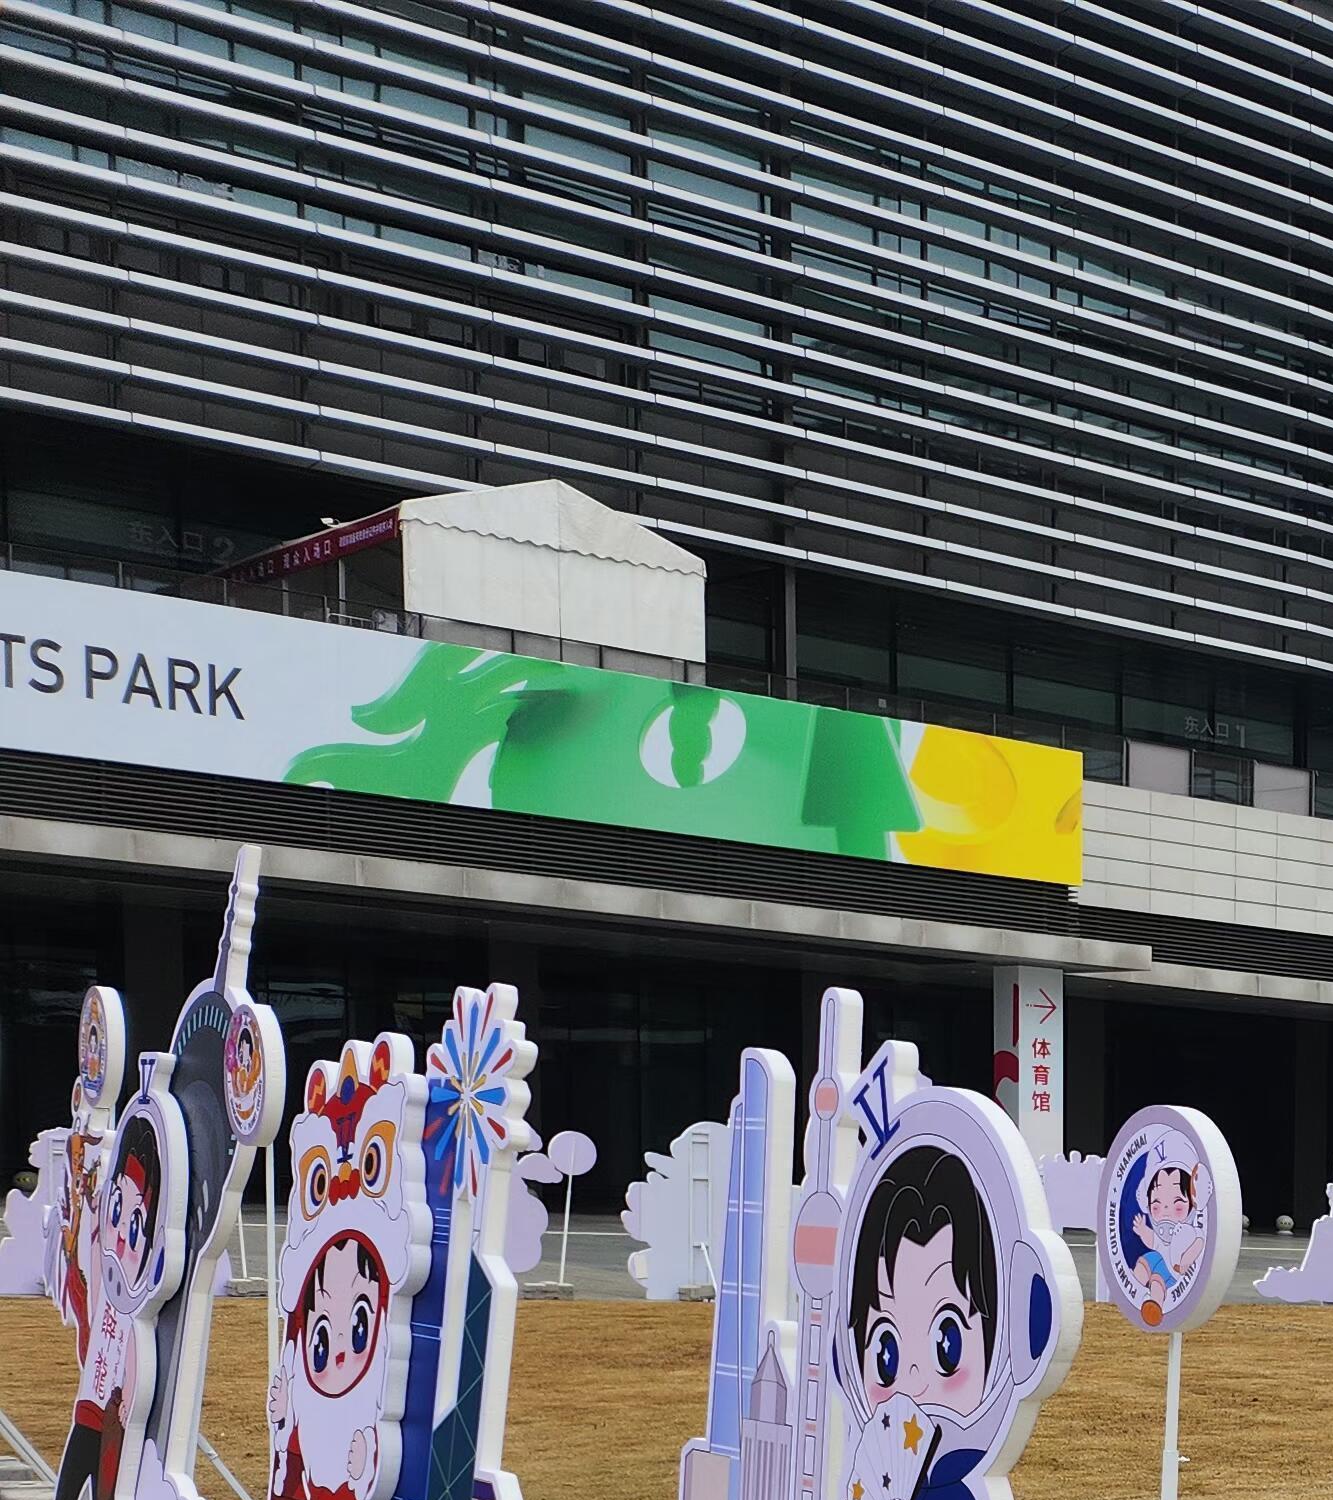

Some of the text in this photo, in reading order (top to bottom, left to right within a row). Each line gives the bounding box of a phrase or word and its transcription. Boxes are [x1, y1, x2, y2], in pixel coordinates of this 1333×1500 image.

[83, 644, 246, 721] PARK
[1031, 1037, 1052, 1113] 体育馆
[1116, 1133, 1148, 1182] SHANGHAI
[1106, 1200, 1137, 1300] PLANET CULTURE
